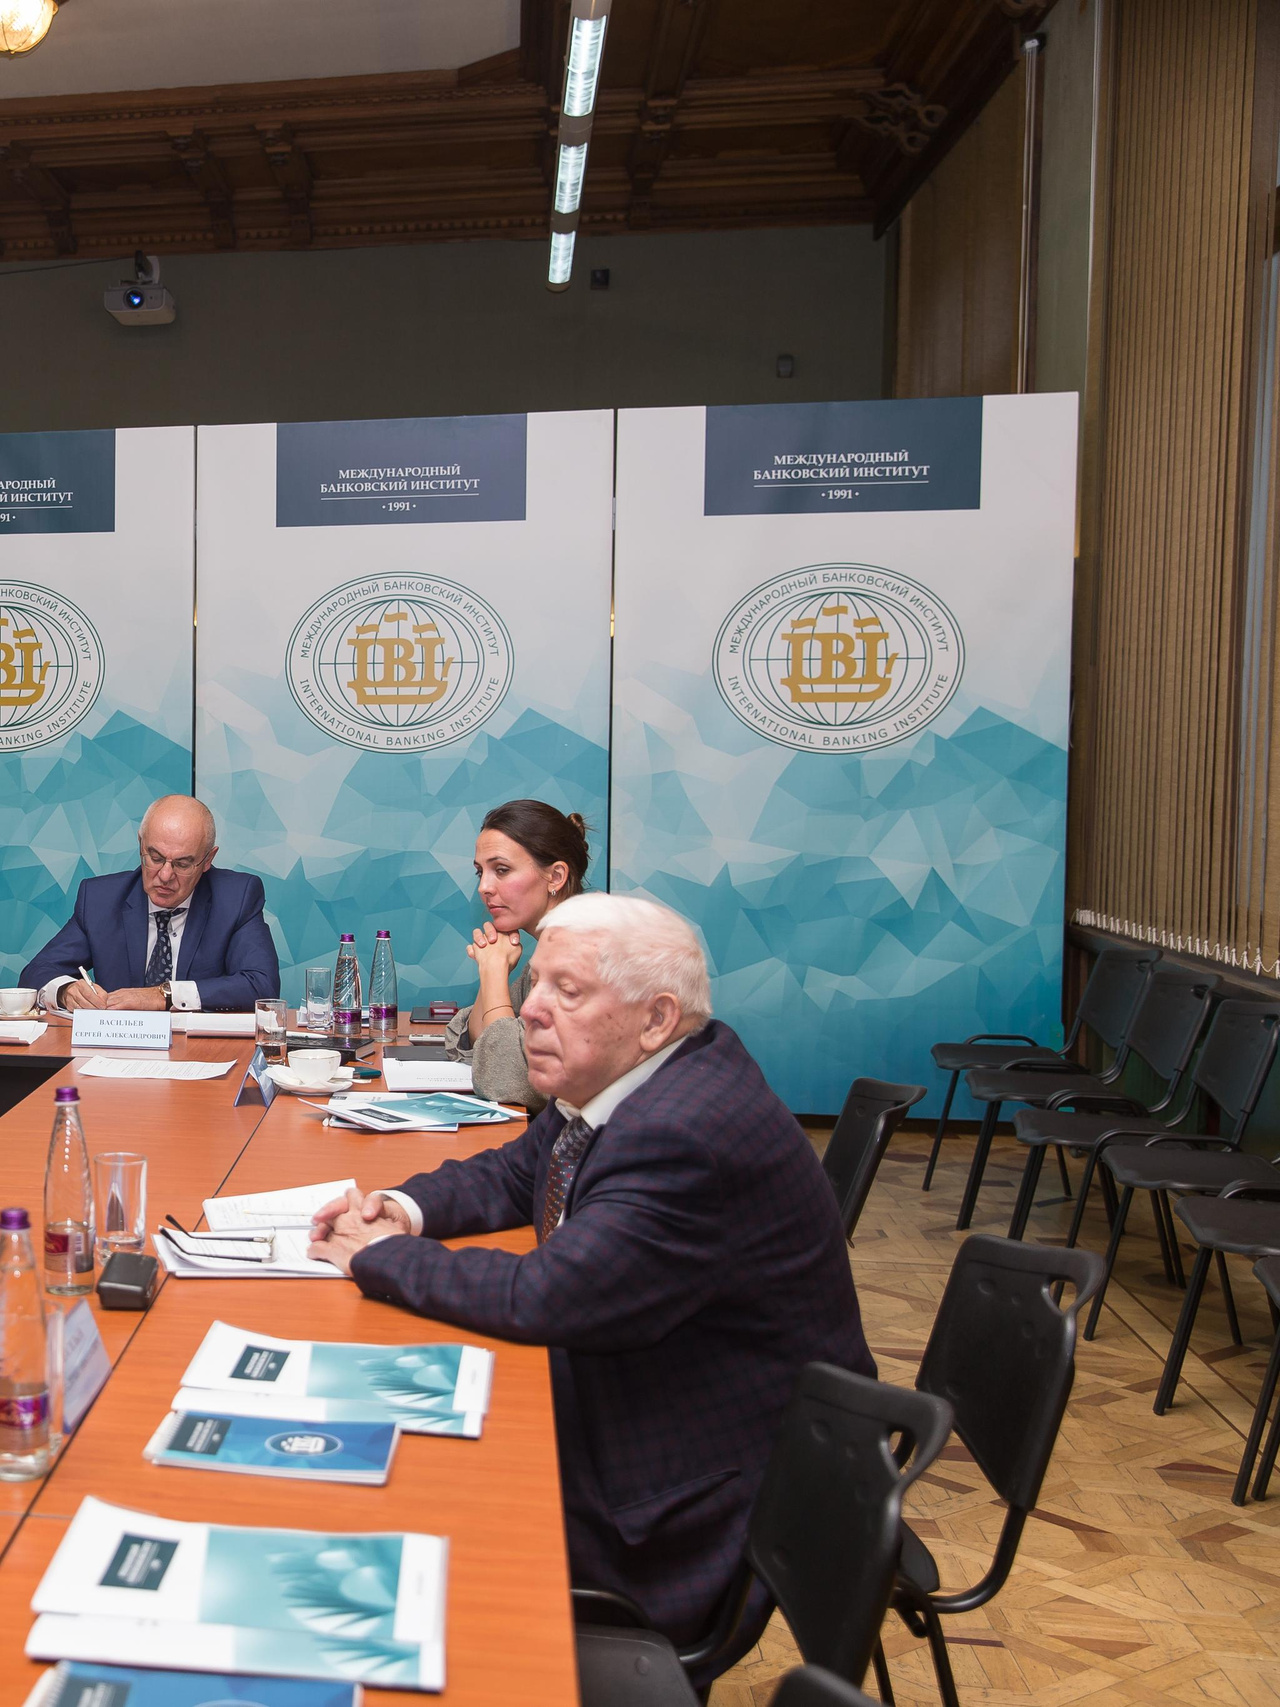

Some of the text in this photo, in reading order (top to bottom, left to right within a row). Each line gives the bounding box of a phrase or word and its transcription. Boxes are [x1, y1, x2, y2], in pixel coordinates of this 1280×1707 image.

[338, 464, 461, 480] МЕЖДУНАРОДНЫЙ
[753, 465, 930, 480] БАНКОВСКИЙ ИНСТИТУТ
[774, 449, 909, 466] МЕЖДУНАРОДНЫЙ
[10, 492, 73, 503] ИНСТИТУТ
[320, 478, 480, 493] БАНКОВСКИЙ ИНСТИТУТ
[300, 581, 500, 659] МЕЖДУНАРОДНЫЙ БАНКОВСКИЙ ИНСТИТУТ
[728, 572, 949, 654] МЕЖДУНАРОДНЫЙ БАНКОВСКИЙ ИНСТИТУТ
[58, 606, 92, 661] ИНСТИТУТ
[47, 680, 92, 734] INSTITUTE
[299, 677, 499, 746] INTERNATIONAL BANKING INSTITUTE
[727, 673, 949, 747] INTERNATIONAL BANKING INSTITUTE
[99, 1019, 144, 1027] ВАСИЛЬЕВ
